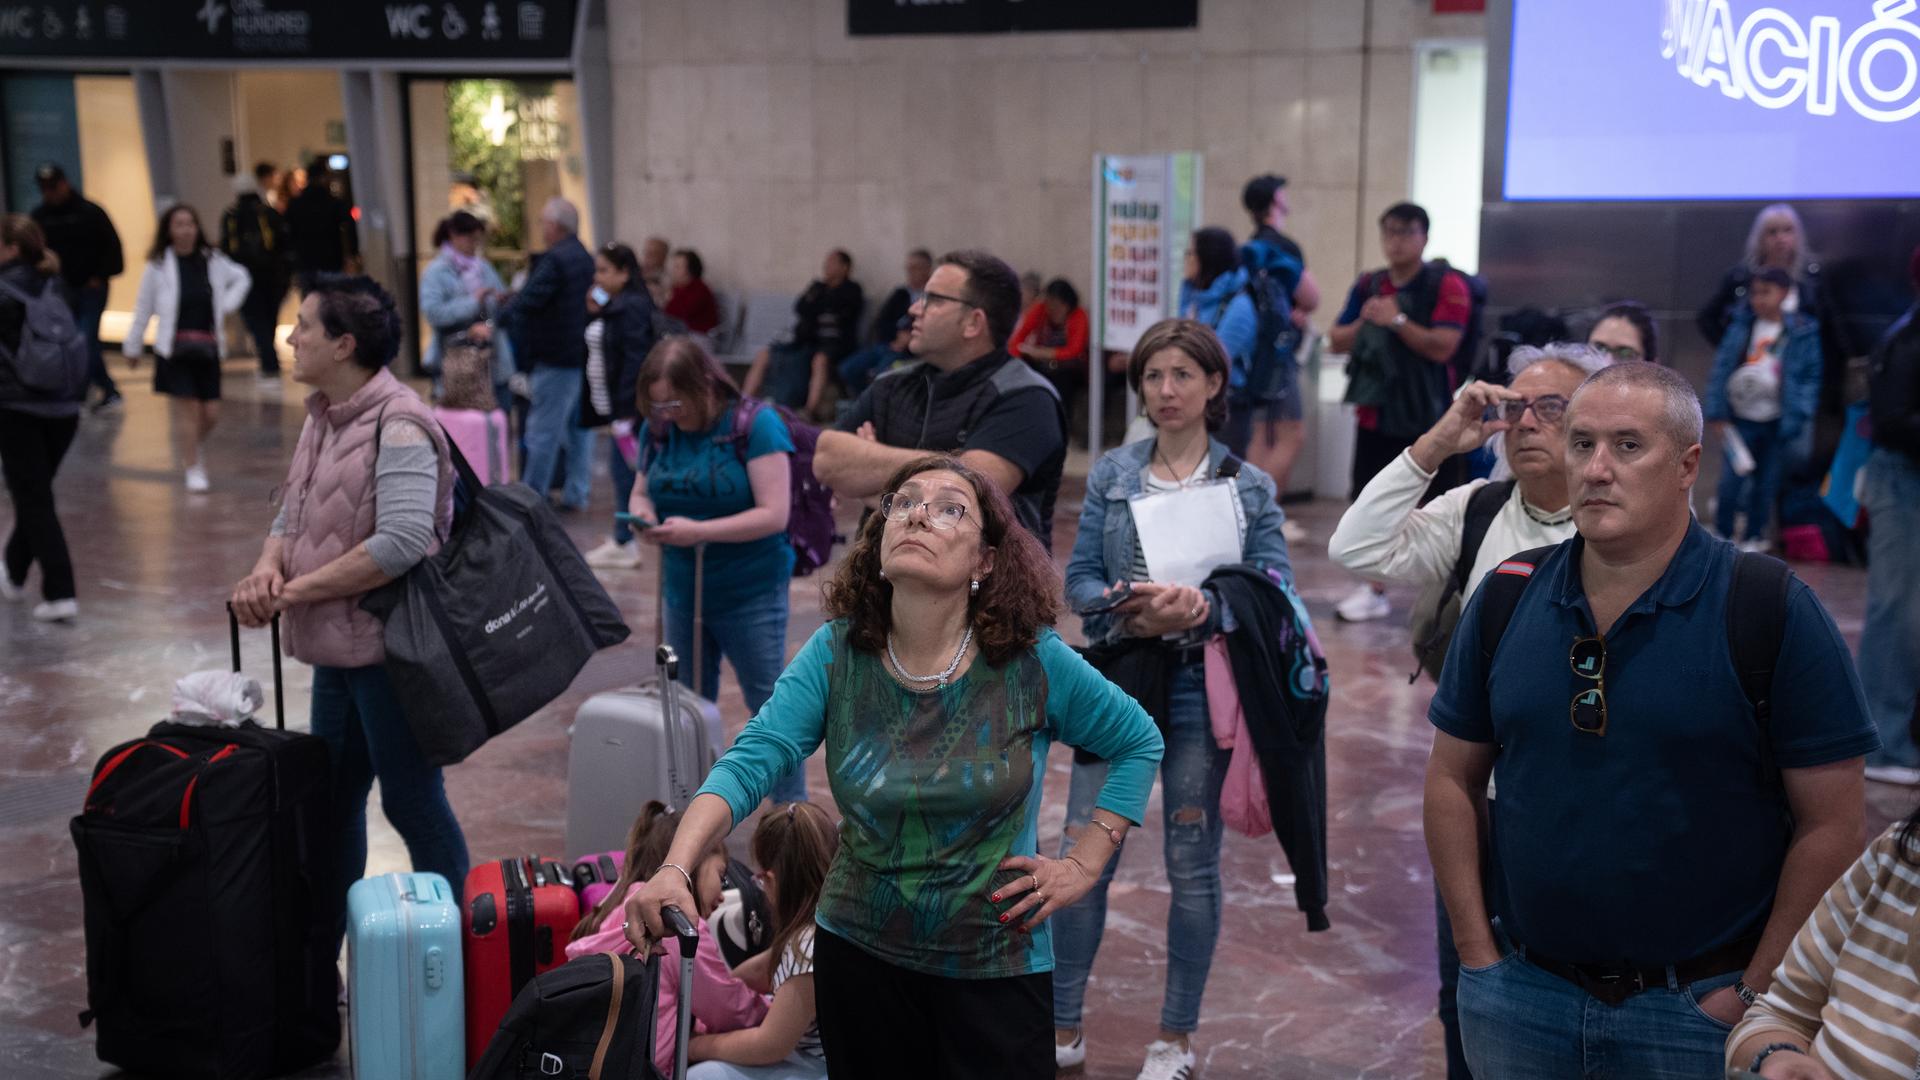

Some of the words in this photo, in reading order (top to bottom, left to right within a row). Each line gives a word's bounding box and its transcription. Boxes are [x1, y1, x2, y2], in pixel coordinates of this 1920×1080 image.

[0, 6, 33, 39] WC
[232, 11, 311, 35] HUNDRED
[384, 4, 432, 40] WC
